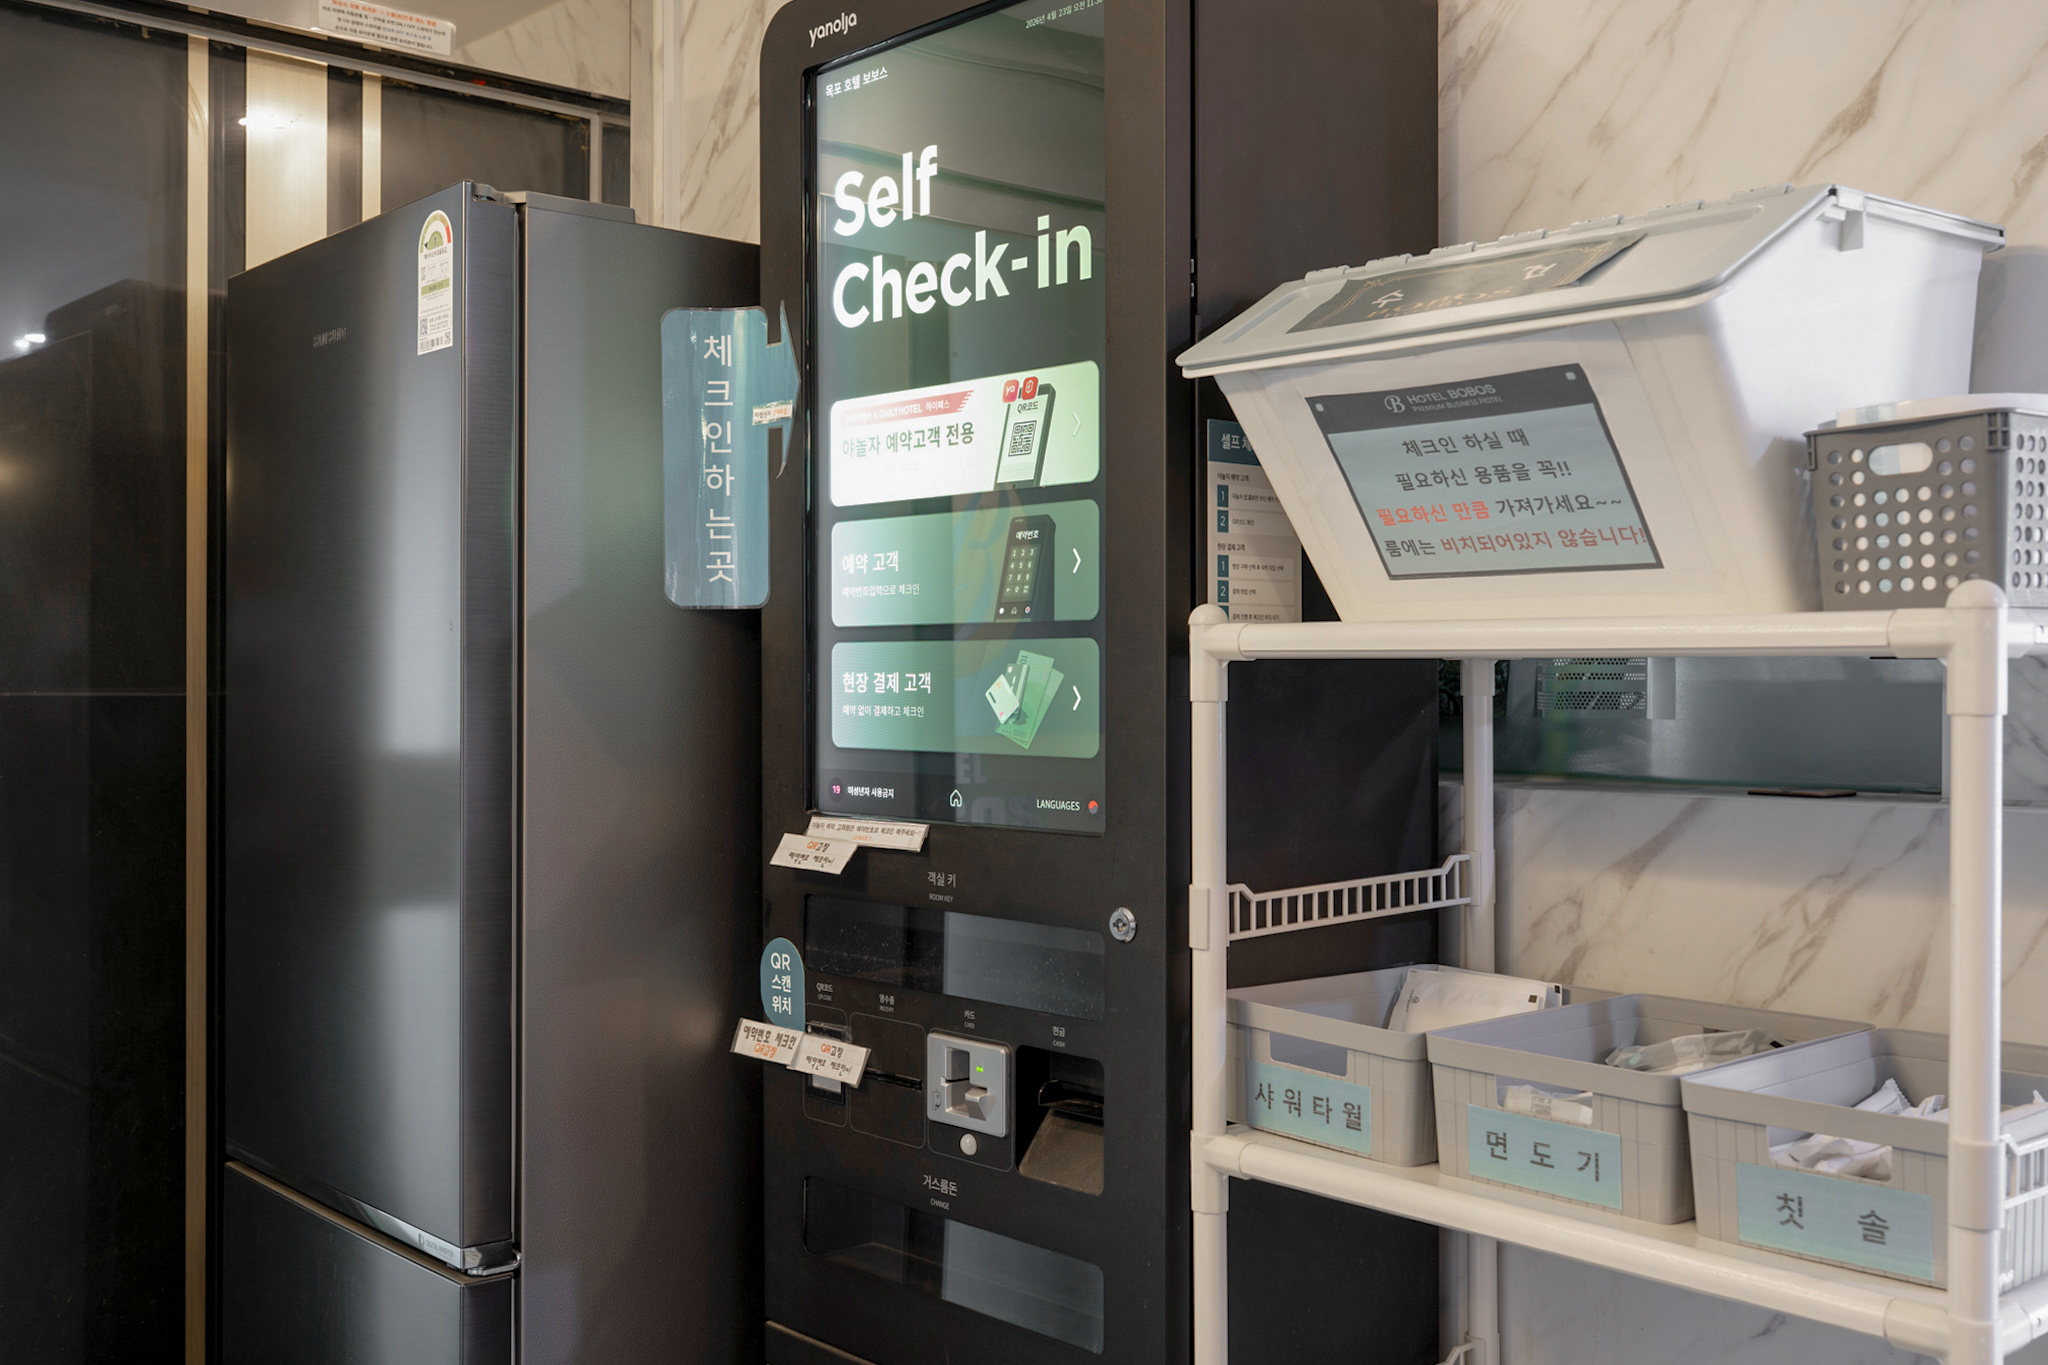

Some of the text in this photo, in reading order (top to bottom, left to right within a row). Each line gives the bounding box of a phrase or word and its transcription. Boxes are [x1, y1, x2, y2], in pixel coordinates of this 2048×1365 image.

[1046, 10, 1057, 20] 4월
[1058, 5, 1072, 17] 23일
[1073, 0, 1086, 12] 오전
[809, 12, 857, 48] yanolja
[825, 66, 888, 98] 목포 호텔 보보스
[833, 144, 938, 237] Self
[832, 214, 1093, 329] Check-in
[313, 326, 337, 348] SAMSUNG
[1406, 392, 1448, 405] HOTEL
[1446, 384, 1496, 399] BOBOS
[880, 403, 923, 418] DAILYHOTEL
[925, 399, 950, 412] 하이패스
[1017, 401, 1039, 414] QR코드
[1412, 404, 1446, 413] PREMIUM
[1446, 400, 1480, 409] BUSINESS
[842, 421, 975, 458] 야놀자 예약고객 전용
[1221, 433, 1241, 450] 셀프
[1401, 428, 1530, 458] 체크인 하실 때
[1394, 459, 1572, 492] 필요하신 용품을 꼭!!
[1221, 490, 1225, 501] 1
[1220, 515, 1226, 527] 2
[1376, 503, 1449, 527] 필요하신
[1452, 500, 1490, 521] 만큼
[1236, 543, 1246, 552] 고객
[1384, 525, 1648, 558] 룸에는 비치되어있지 않습니다!
[1021, 549, 1025, 557] 2
[842, 550, 899, 575] 예약 고객
[1221, 561, 1225, 571] 1
[842, 583, 920, 598] 예약번호입력으로 체크인
[1220, 585, 1226, 597] 2
[842, 671, 931, 694] 현장 결제 고객
[842, 704, 925, 718] 예약 없이 결제하고 체크인
[832, 785, 841, 794] 19
[847, 786, 895, 799] 미성년자 사용금지
[1036, 799, 1080, 812] LANGUAGES
[880, 827, 894, 836] 체크인
[806, 841, 831, 853] QR고장
[927, 871, 957, 888] 객실 키
[929, 893, 954, 903] ROOM KEY
[770, 952, 791, 971] QR
[771, 974, 792, 993] 스캔
[816, 982, 834, 993] QR코드
[771, 995, 792, 1015] 위치
[879, 993, 896, 1006] 영수증
[963, 1009, 976, 1020] 카드
[743, 1025, 797, 1050] 예약번호 체크인
[1052, 1026, 1066, 1038] 현금
[754, 1043, 778, 1059] QR고장
[820, 1043, 844, 1059] QR고장
[1052, 1040, 1066, 1048] CASH
[1254, 1083, 1362, 1132] 샤워타월
[922, 1174, 958, 1197] 거스름돈
[930, 1197, 950, 1211] CHANGE
